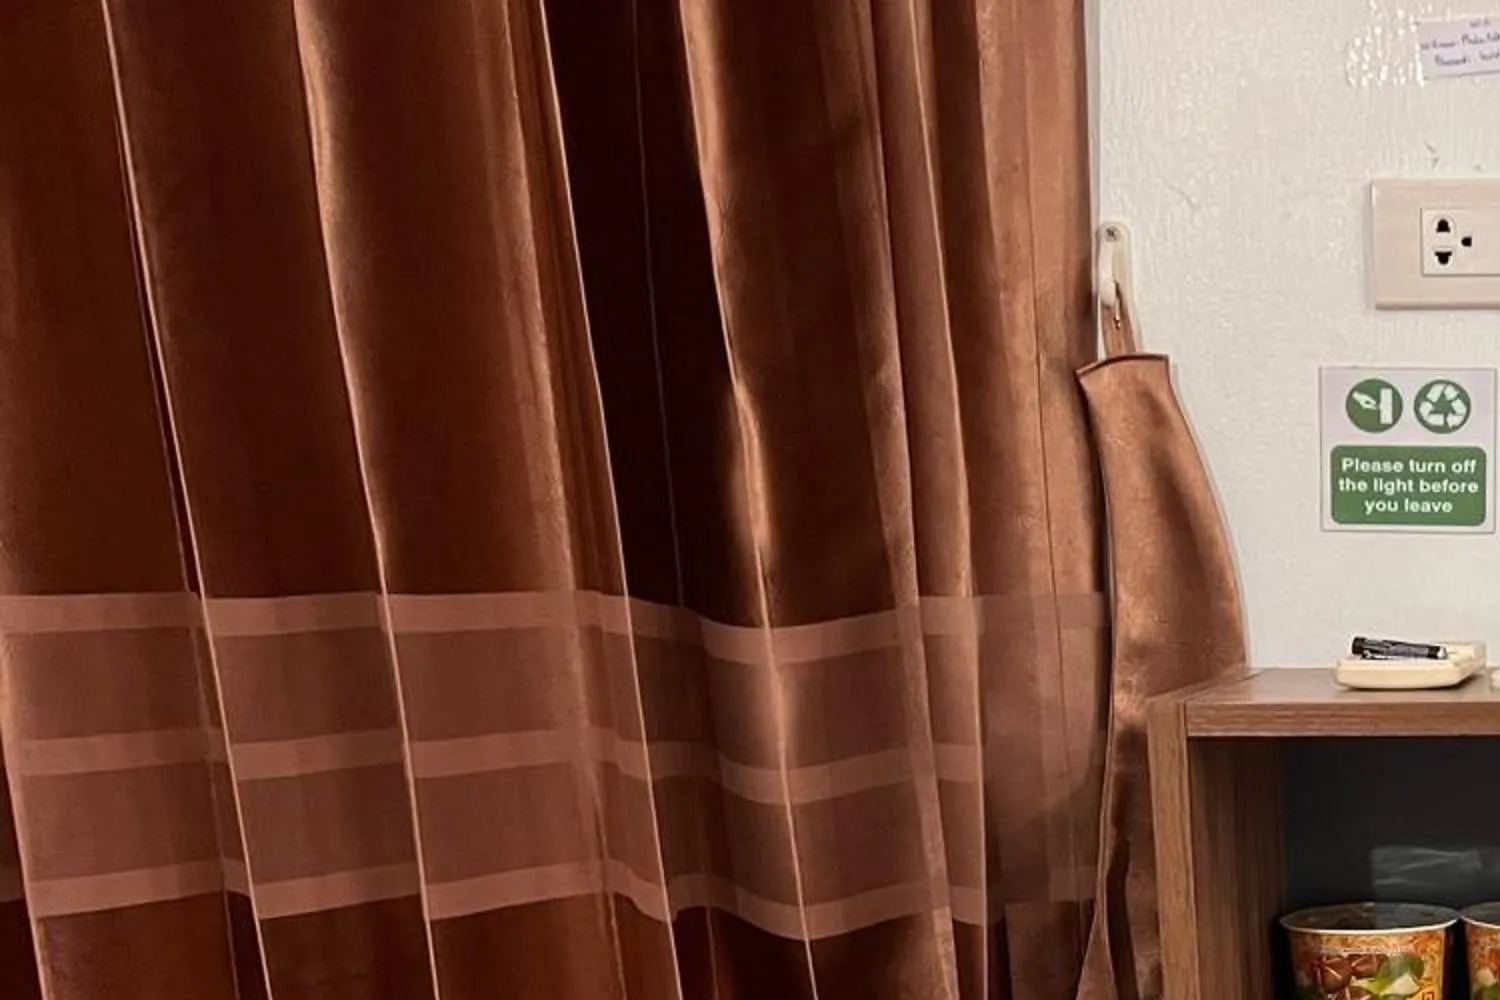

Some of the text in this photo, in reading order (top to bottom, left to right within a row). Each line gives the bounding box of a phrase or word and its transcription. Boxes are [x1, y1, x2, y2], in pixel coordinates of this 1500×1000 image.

[1341, 457, 1477, 473] Please turn off
[1338, 477, 1479, 495] the light before
[1364, 499, 1453, 516] you leave
